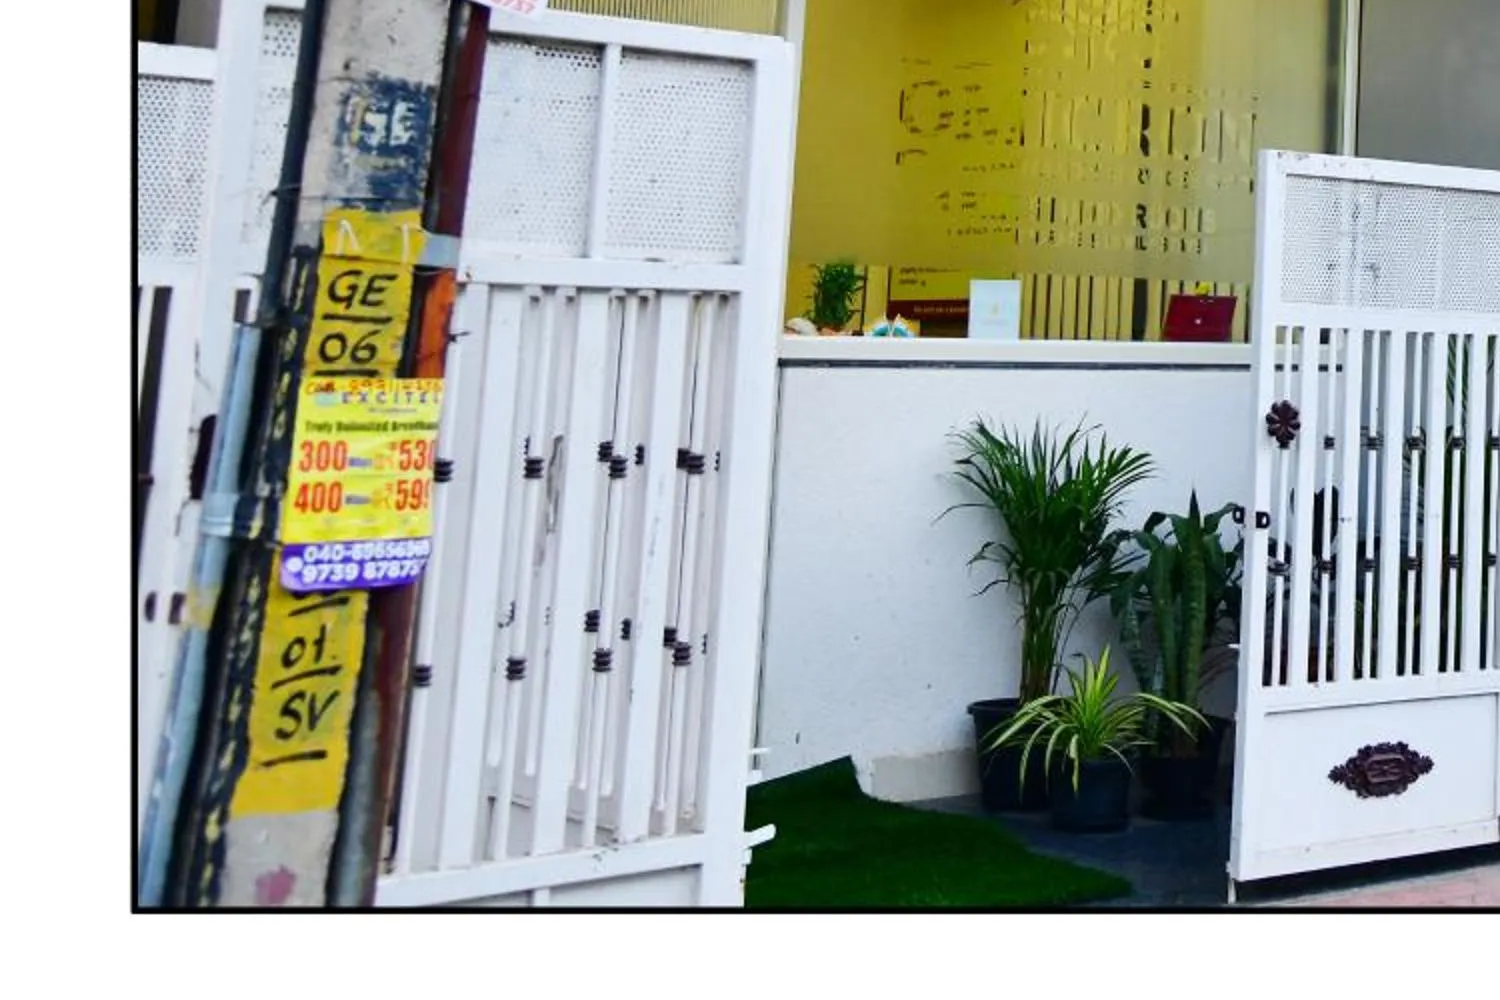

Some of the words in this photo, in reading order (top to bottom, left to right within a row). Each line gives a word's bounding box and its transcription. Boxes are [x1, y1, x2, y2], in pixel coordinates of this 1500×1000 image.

[328, 269, 398, 310] GE
[318, 329, 382, 365] 06
[299, 440, 348, 472] 300
[294, 480, 343, 514] 400
[275, 690, 341, 740] SV
